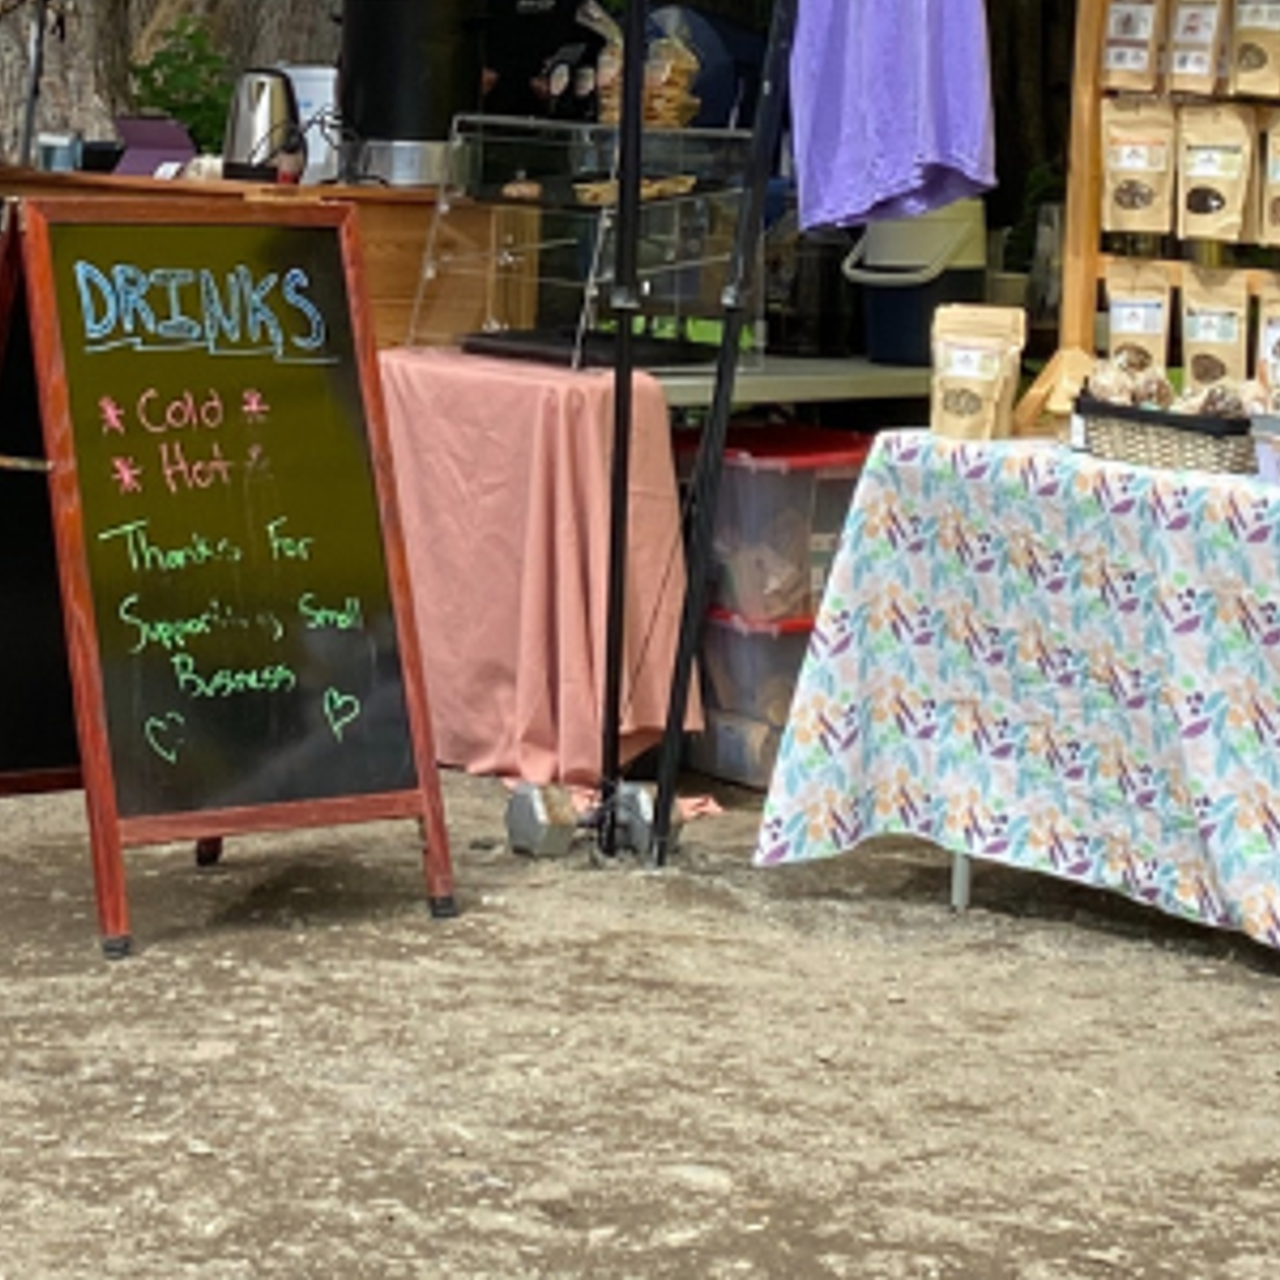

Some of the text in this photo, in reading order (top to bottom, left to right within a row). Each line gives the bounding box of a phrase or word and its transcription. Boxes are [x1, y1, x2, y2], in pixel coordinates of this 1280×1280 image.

[73, 259, 325, 349] DRINKS
[135, 388, 224, 432] Cold
[160, 445, 233, 493] Hot
[97, 519, 242, 571] Thanks
[119, 593, 362, 654] Supporg Small
